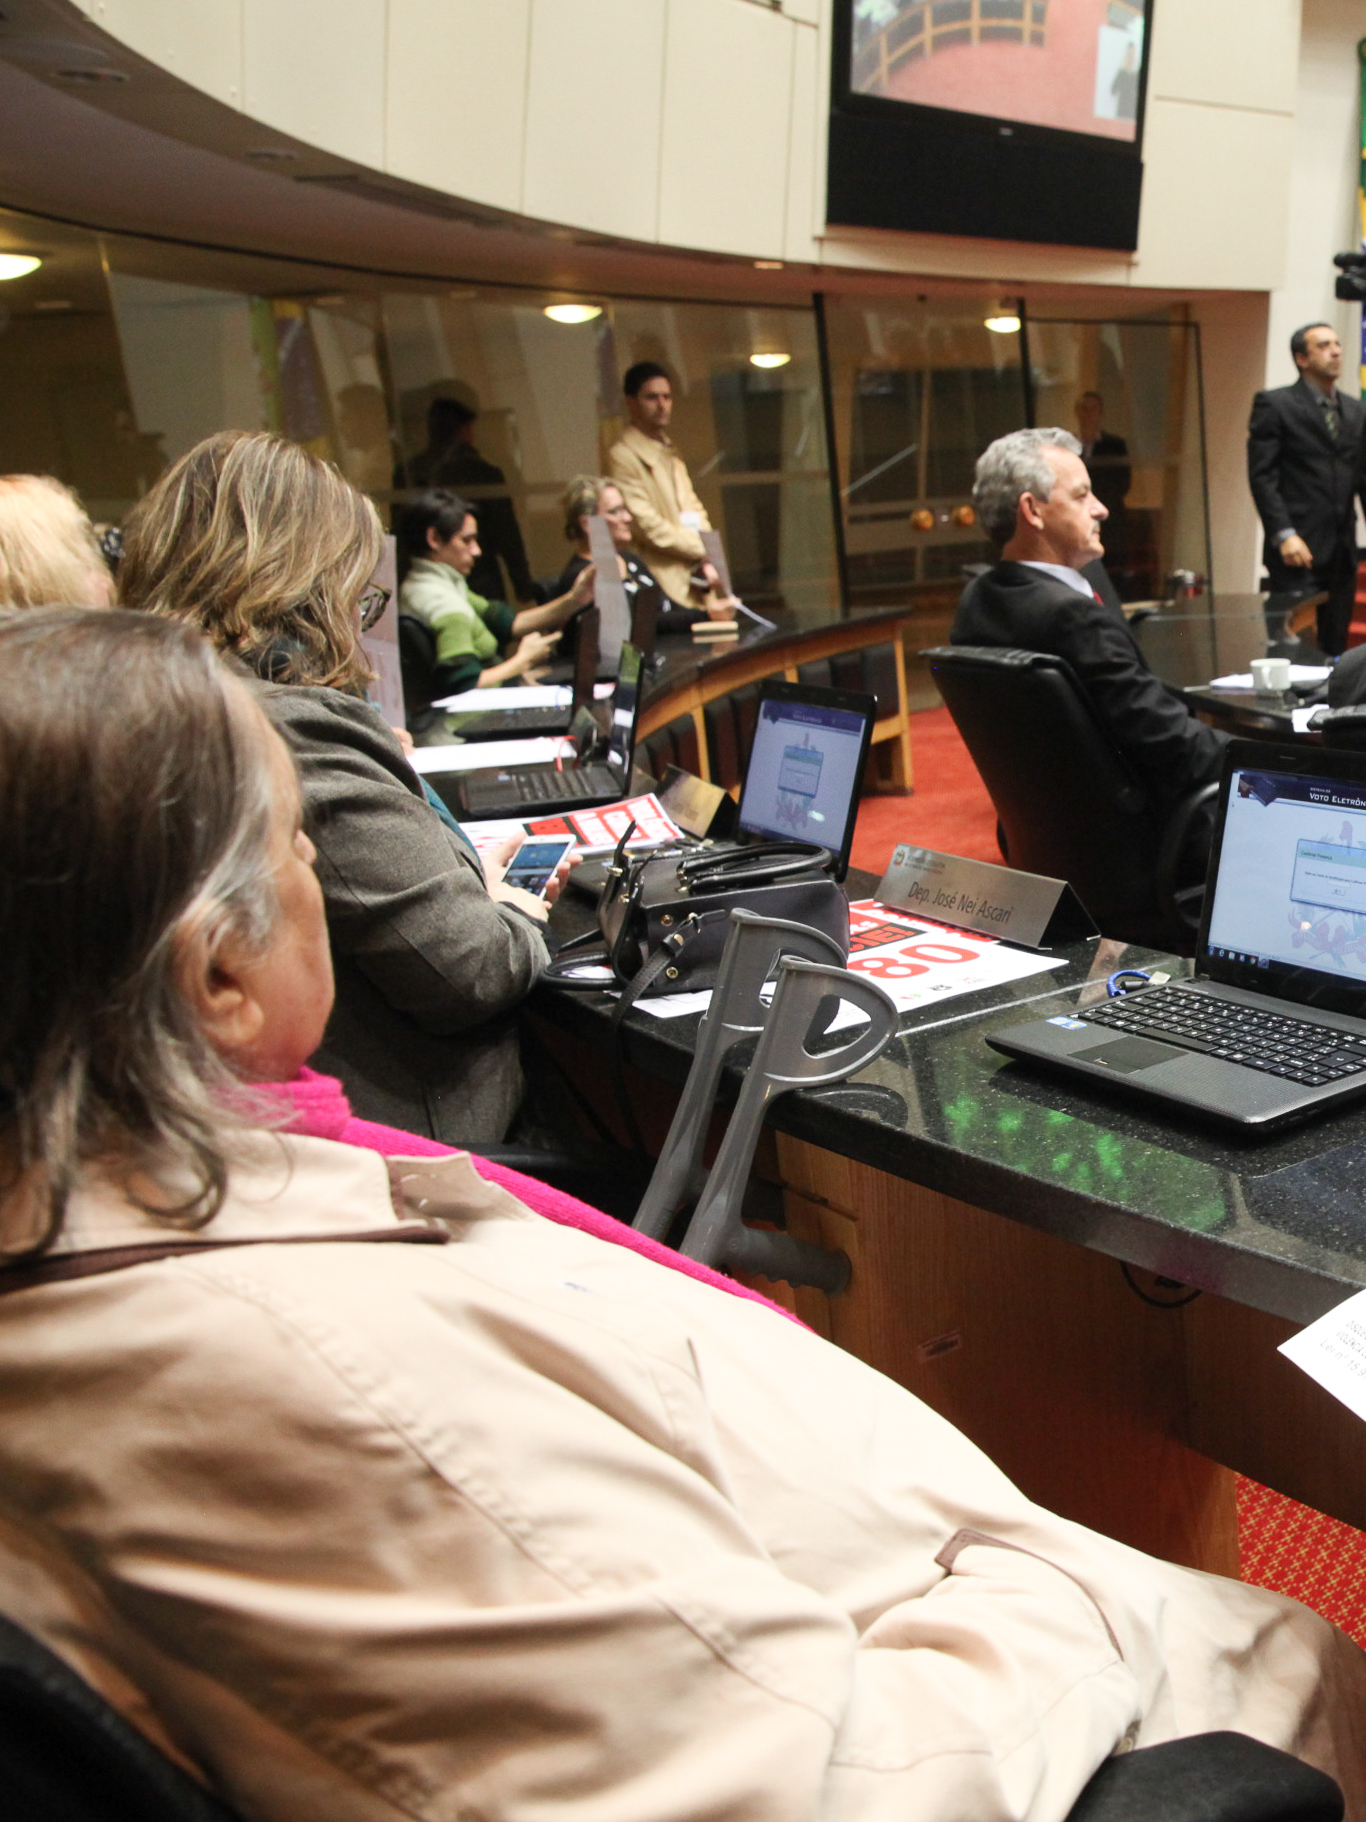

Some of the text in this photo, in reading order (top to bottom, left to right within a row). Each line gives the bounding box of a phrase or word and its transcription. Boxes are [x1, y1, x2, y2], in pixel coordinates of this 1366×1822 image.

[1309, 792, 1329, 802] VOTO
[907, 881, 930, 906] Dep.
[932, 887, 957, 910] José
[957, 894, 979, 914] Nei
[975, 901, 1014, 924] Ascari
[846, 944, 980, 979] 80
[1320, 1339, 1333, 1353] Lei
